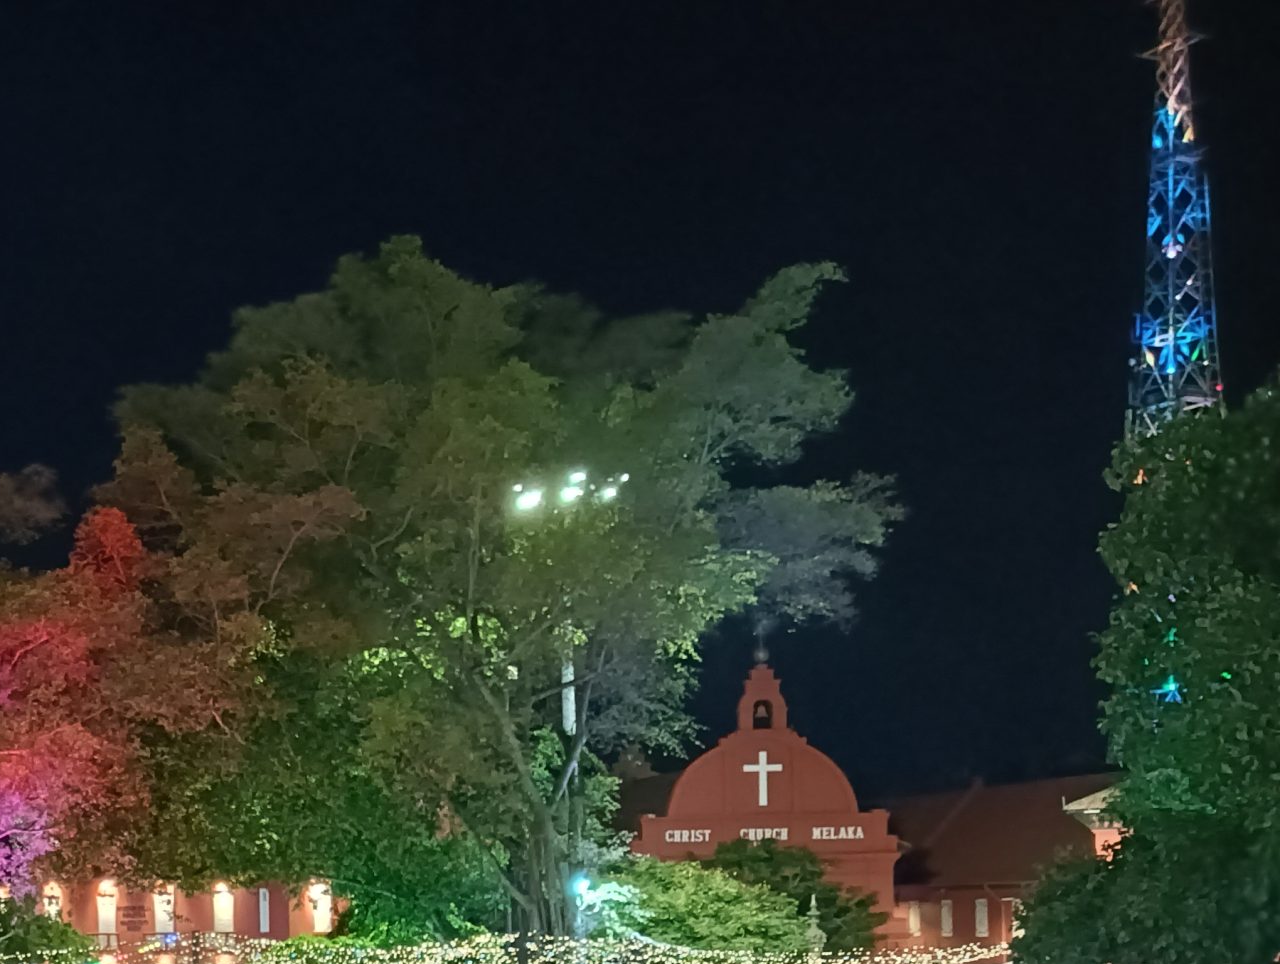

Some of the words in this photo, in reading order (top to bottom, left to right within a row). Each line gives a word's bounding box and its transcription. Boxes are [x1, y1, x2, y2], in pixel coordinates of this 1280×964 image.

[665, 829, 712, 843] CHRIST
[740, 828, 789, 841] CHURCH
[812, 826, 865, 840] MELAKA
